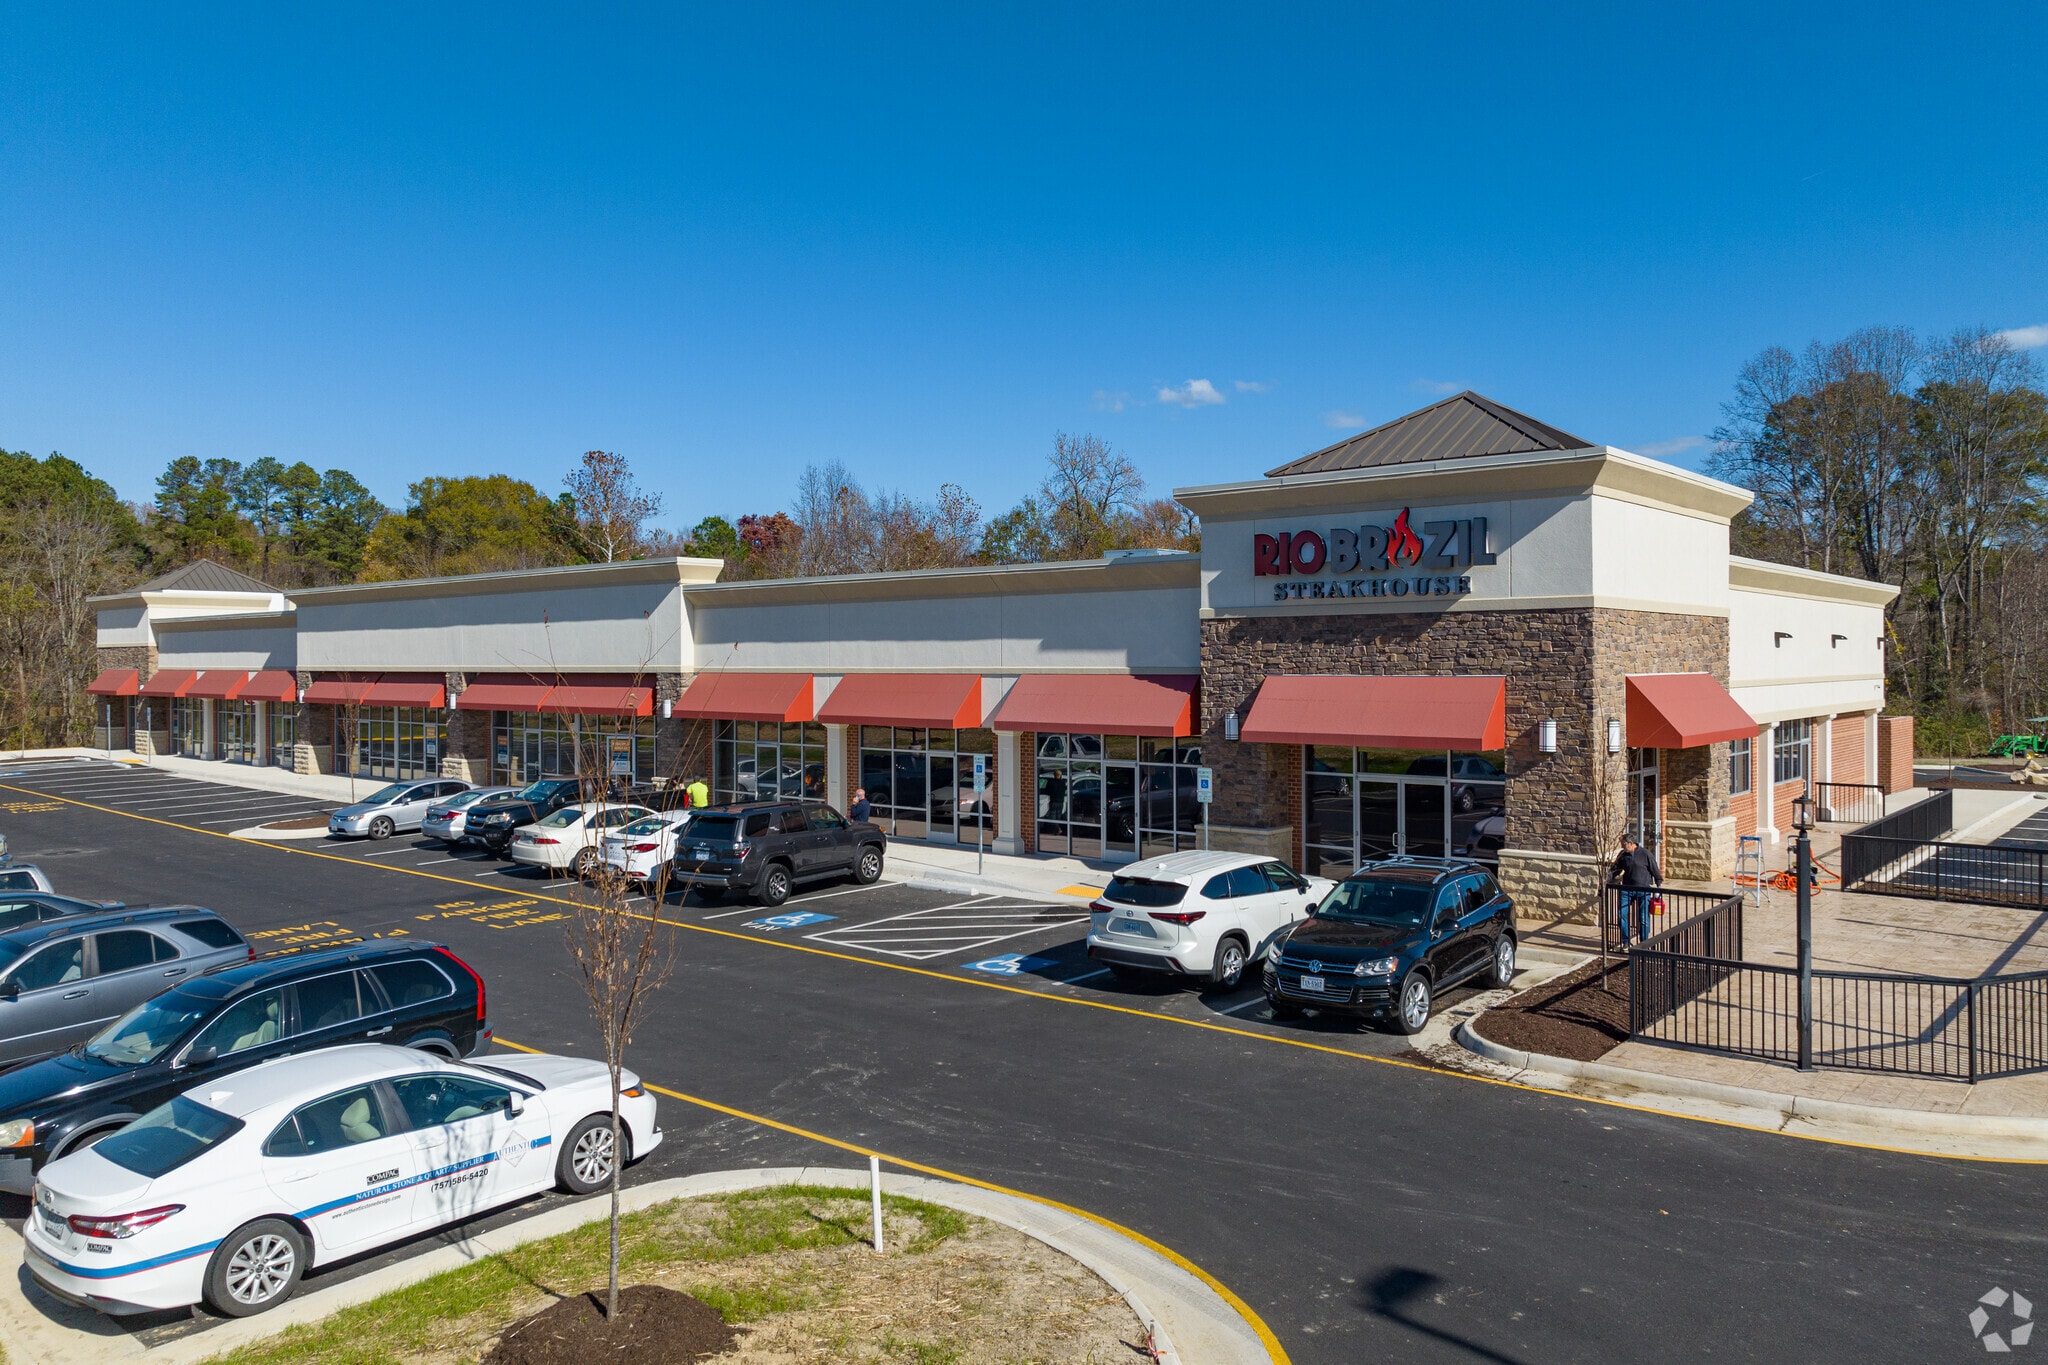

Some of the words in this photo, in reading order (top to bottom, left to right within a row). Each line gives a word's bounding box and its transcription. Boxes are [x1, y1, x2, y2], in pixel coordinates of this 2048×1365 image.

[1254, 530, 1328, 577] RIO
[1274, 575, 1472, 601] STEAKHOUSE
[414, 899, 539, 921] PARKING
[433, 900, 475, 910] NO
[469, 908, 540, 923] FIRE
[487, 912, 573, 930] LANE
[492, 1138, 539, 1161] AUTHENTIC
[355, 1184, 392, 1201] NATURAL
[392, 1176, 417, 1191] STONE
[453, 1156, 485, 1172] SUPPLIER
[367, 1168, 399, 1183] COMPAC
[430, 1168, 489, 1193] (757)586-5420
